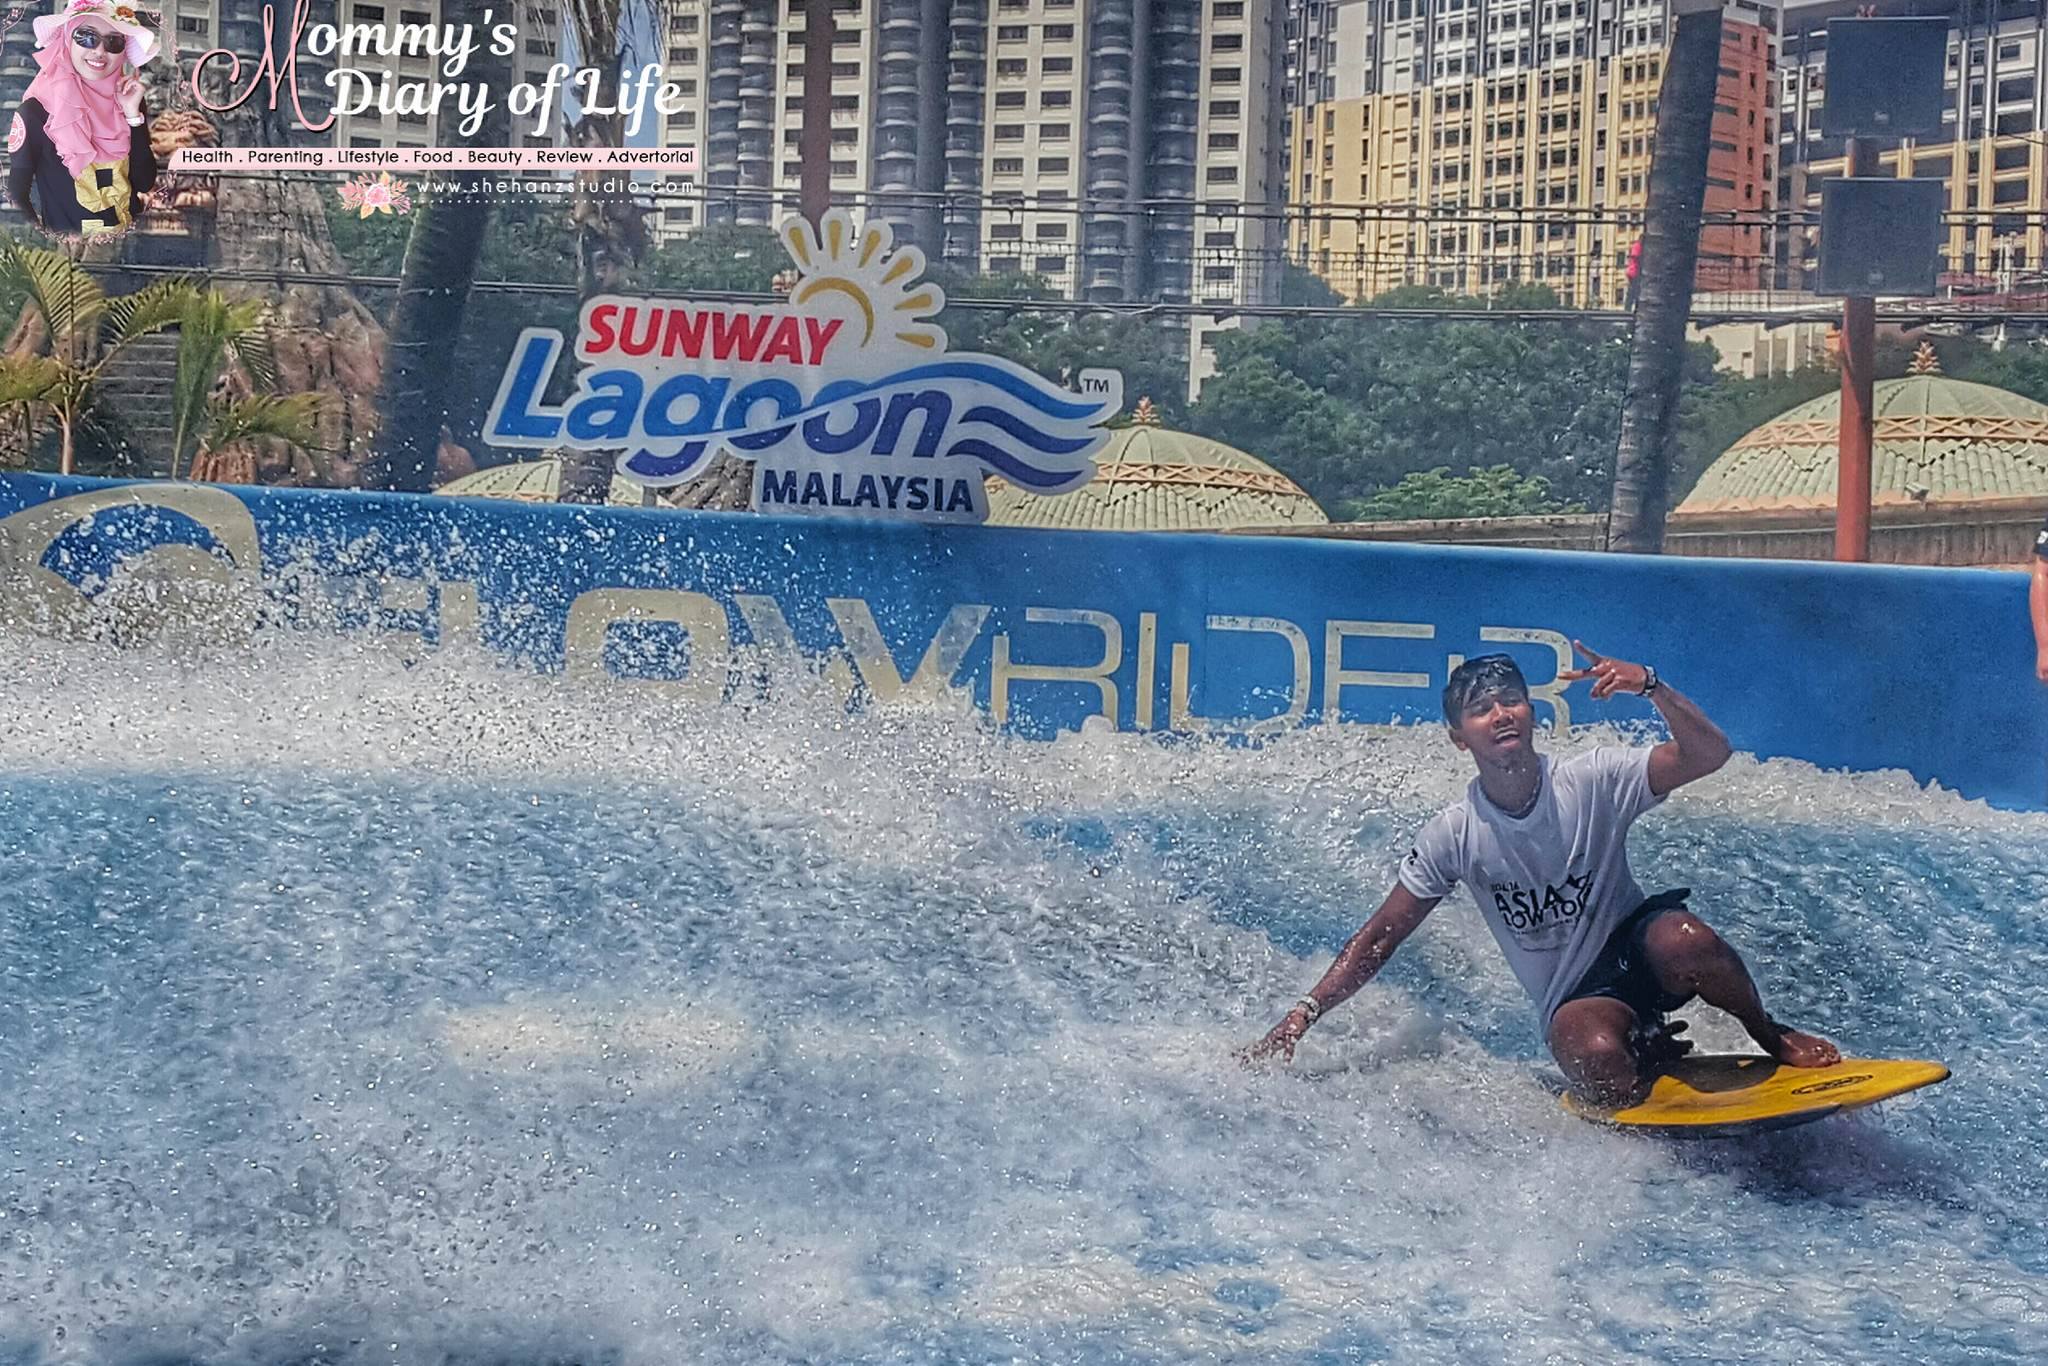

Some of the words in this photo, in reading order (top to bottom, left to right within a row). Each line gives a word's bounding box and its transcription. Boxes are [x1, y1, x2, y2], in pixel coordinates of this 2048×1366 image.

[585, 303, 844, 367] SUNWAY
[492, 337, 956, 480] Lagoon
[1083, 378, 1109, 393] TM
[761, 467, 976, 514] MALAYSIA
[1494, 883, 1565, 914] ASIA
